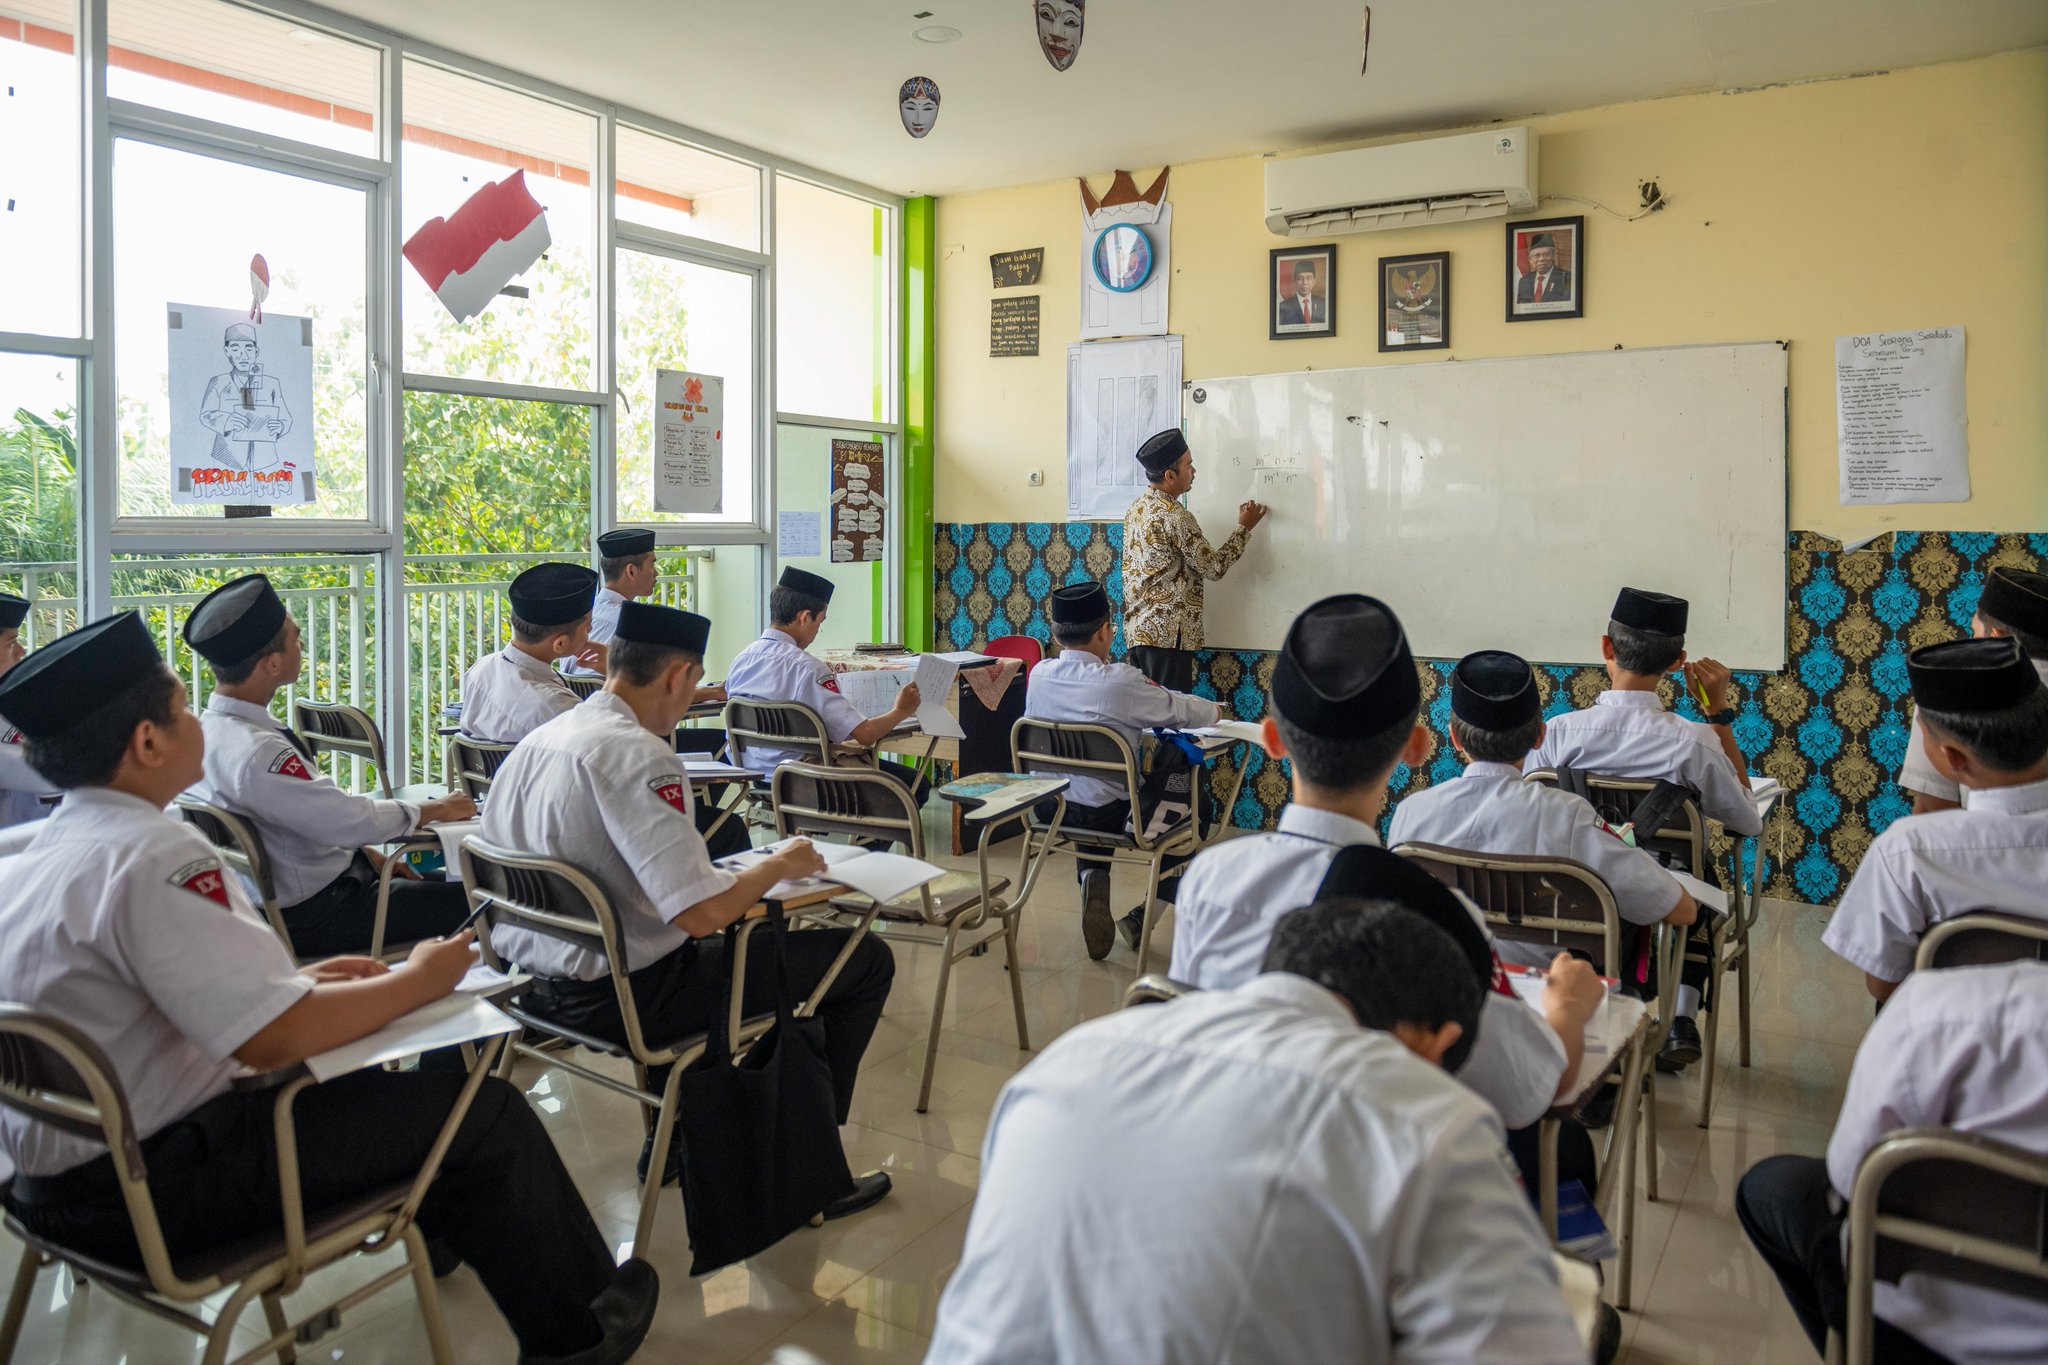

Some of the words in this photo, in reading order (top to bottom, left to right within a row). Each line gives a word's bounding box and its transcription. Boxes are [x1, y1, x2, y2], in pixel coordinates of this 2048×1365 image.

[1853, 336, 1871, 348] DOA
[663, 788, 681, 800] IX
[196, 874, 222, 894] IX
